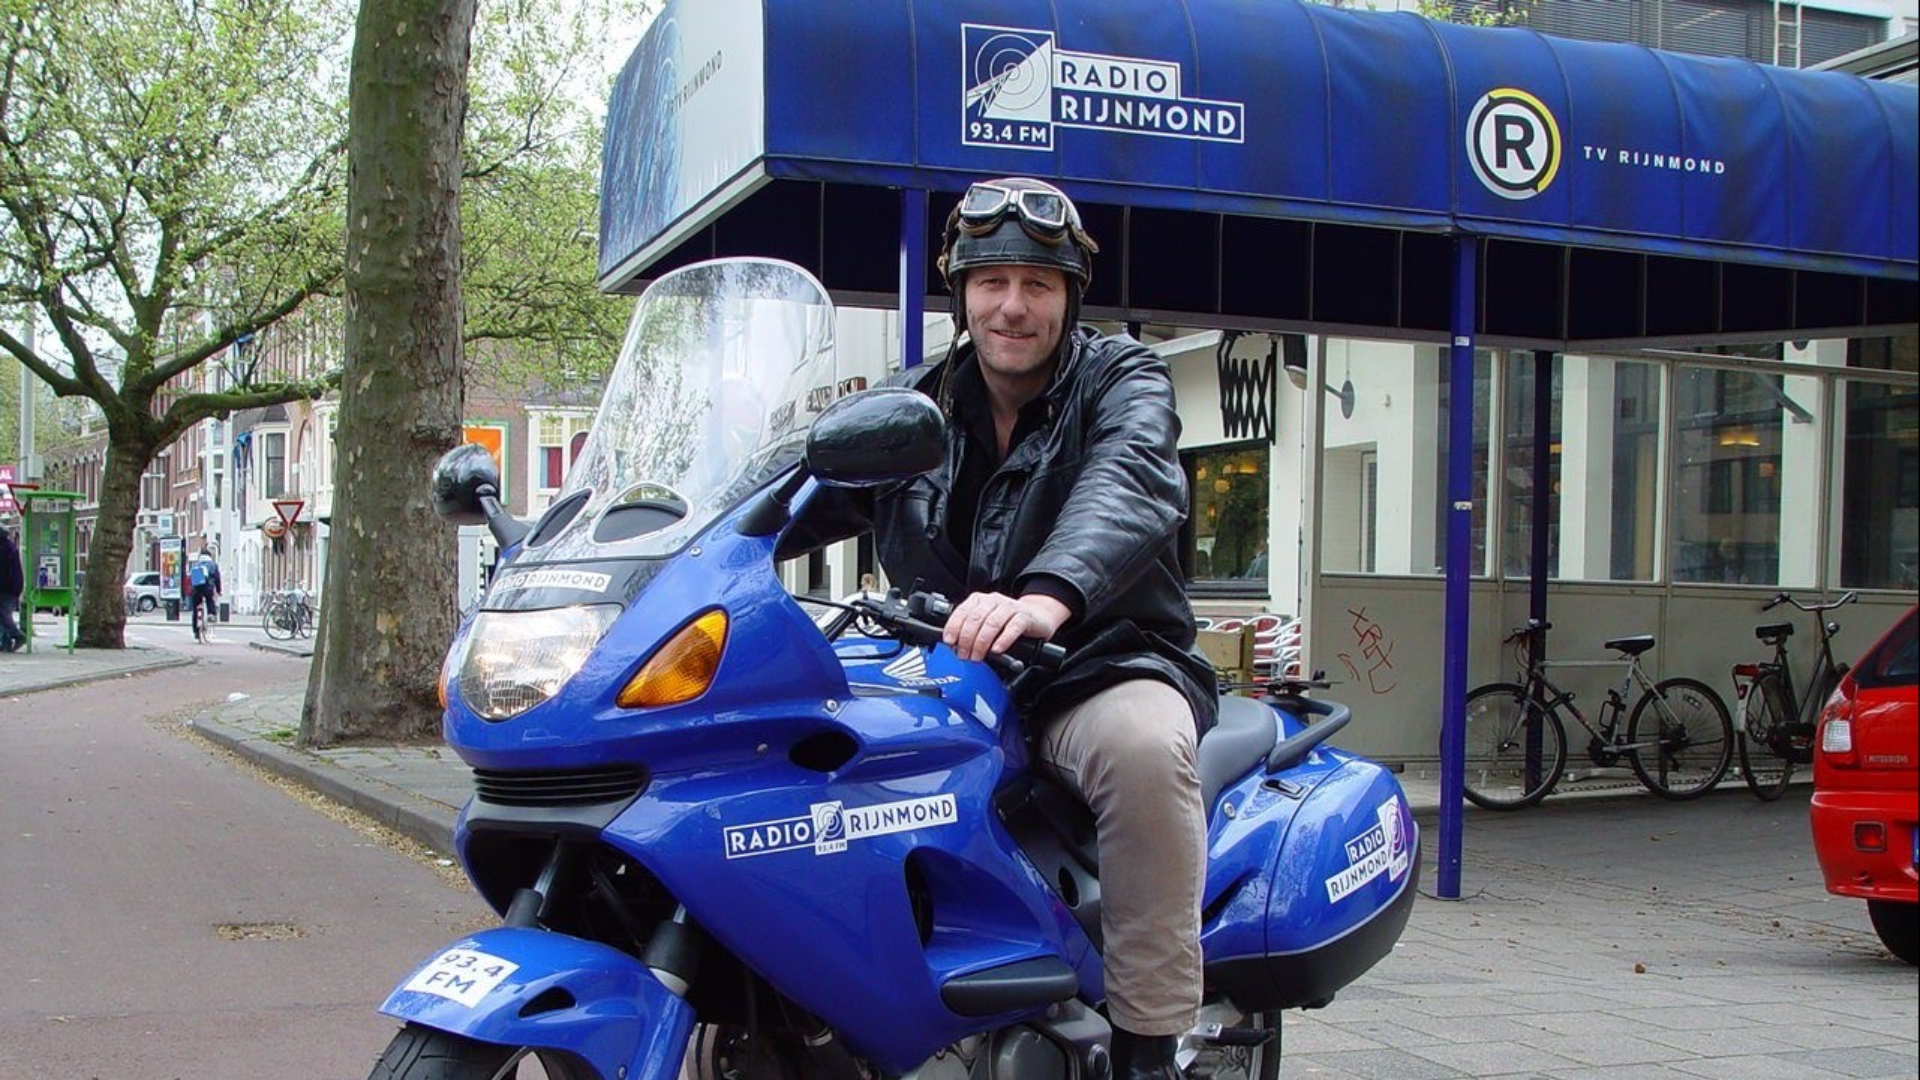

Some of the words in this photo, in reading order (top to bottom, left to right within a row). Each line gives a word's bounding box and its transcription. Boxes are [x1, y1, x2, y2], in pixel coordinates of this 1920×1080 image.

[683, 50, 722, 103] RIJNMOND
[1060, 60, 1167, 93] RADIO
[1060, 94, 1236, 136] RIJNMOND
[970, 122, 1012, 142] 93,4
[1019, 124, 1047, 142] FM
[1494, 113, 1535, 171] R
[1583, 145, 1608, 162] TV
[1619, 150, 1725, 174] RIJNMOND
[529, 573, 605, 588] RIJNMOND
[898, 675, 961, 687] HONDA
[730, 823, 810, 852] RADIO
[850, 800, 953, 833] RIJNMOND
[1349, 829, 1384, 863] RADIO
[1330, 850, 1388, 897] RIJNMOND
[425, 971, 477, 994] FM
